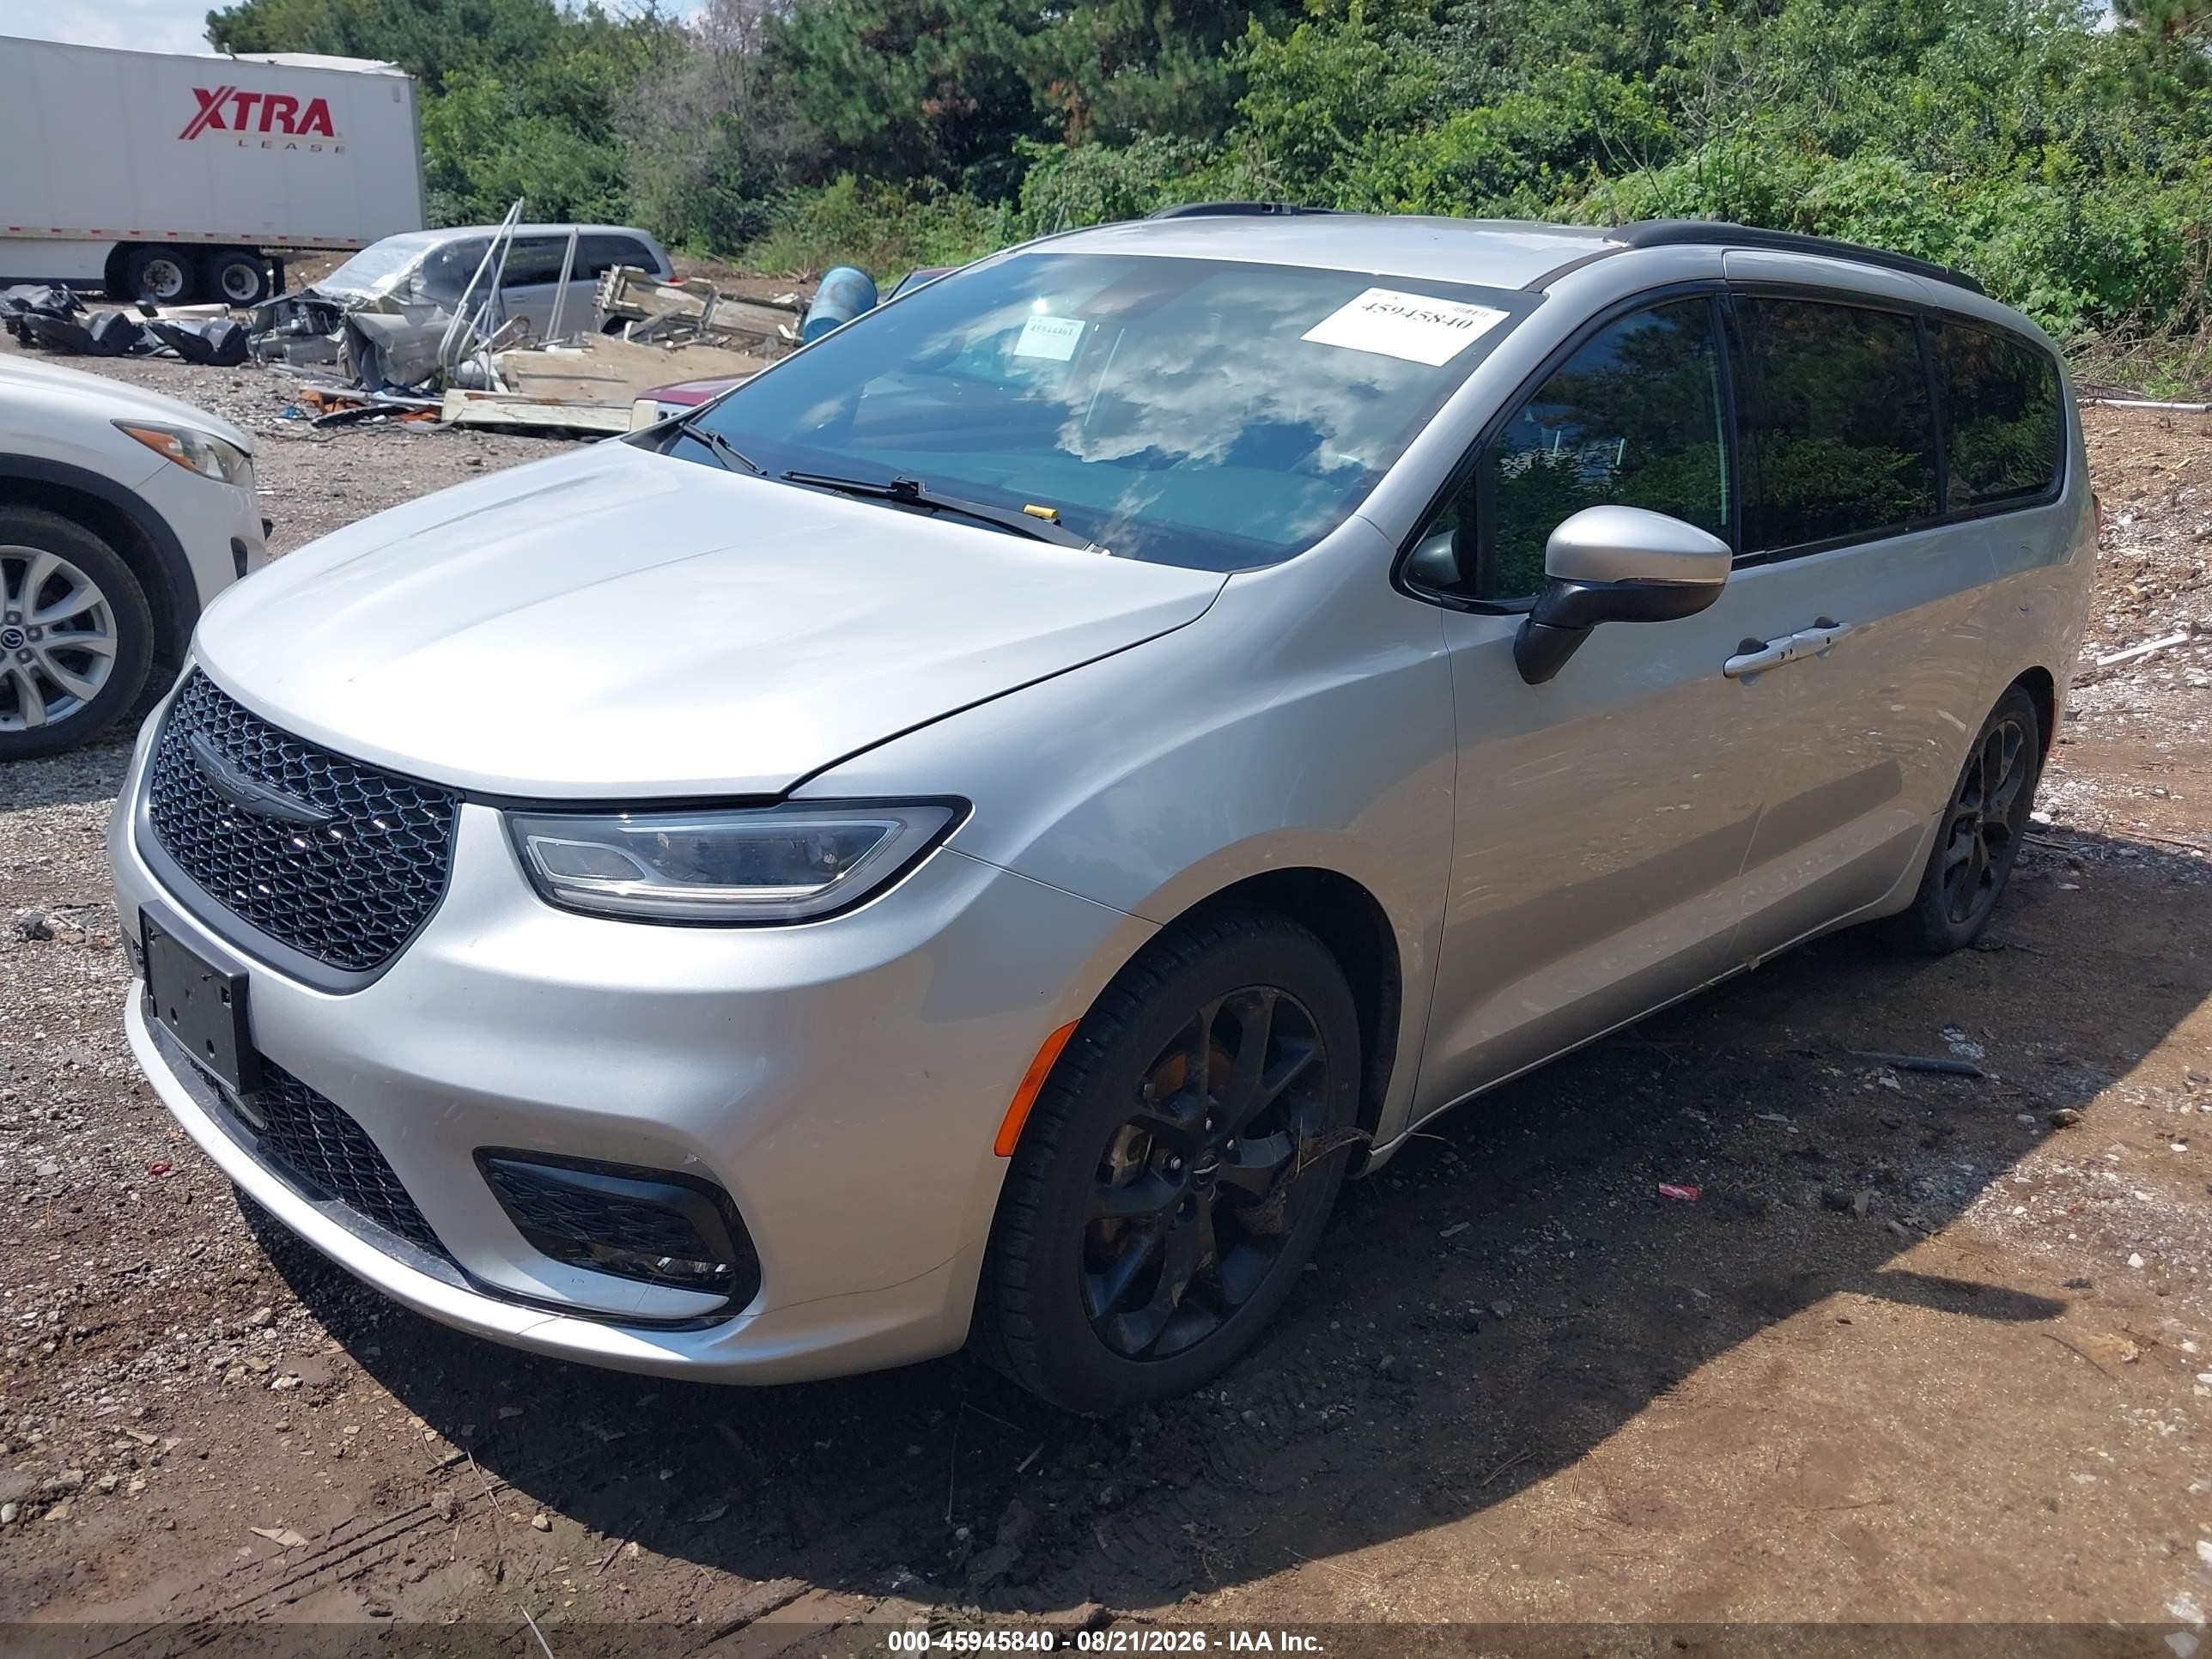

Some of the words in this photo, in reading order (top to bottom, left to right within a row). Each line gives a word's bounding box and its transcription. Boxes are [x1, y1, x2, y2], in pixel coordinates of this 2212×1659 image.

[178, 86, 335, 140] XTRA
[237, 138, 346, 155] LEASE
[1361, 302, 1474, 330] 45945840
